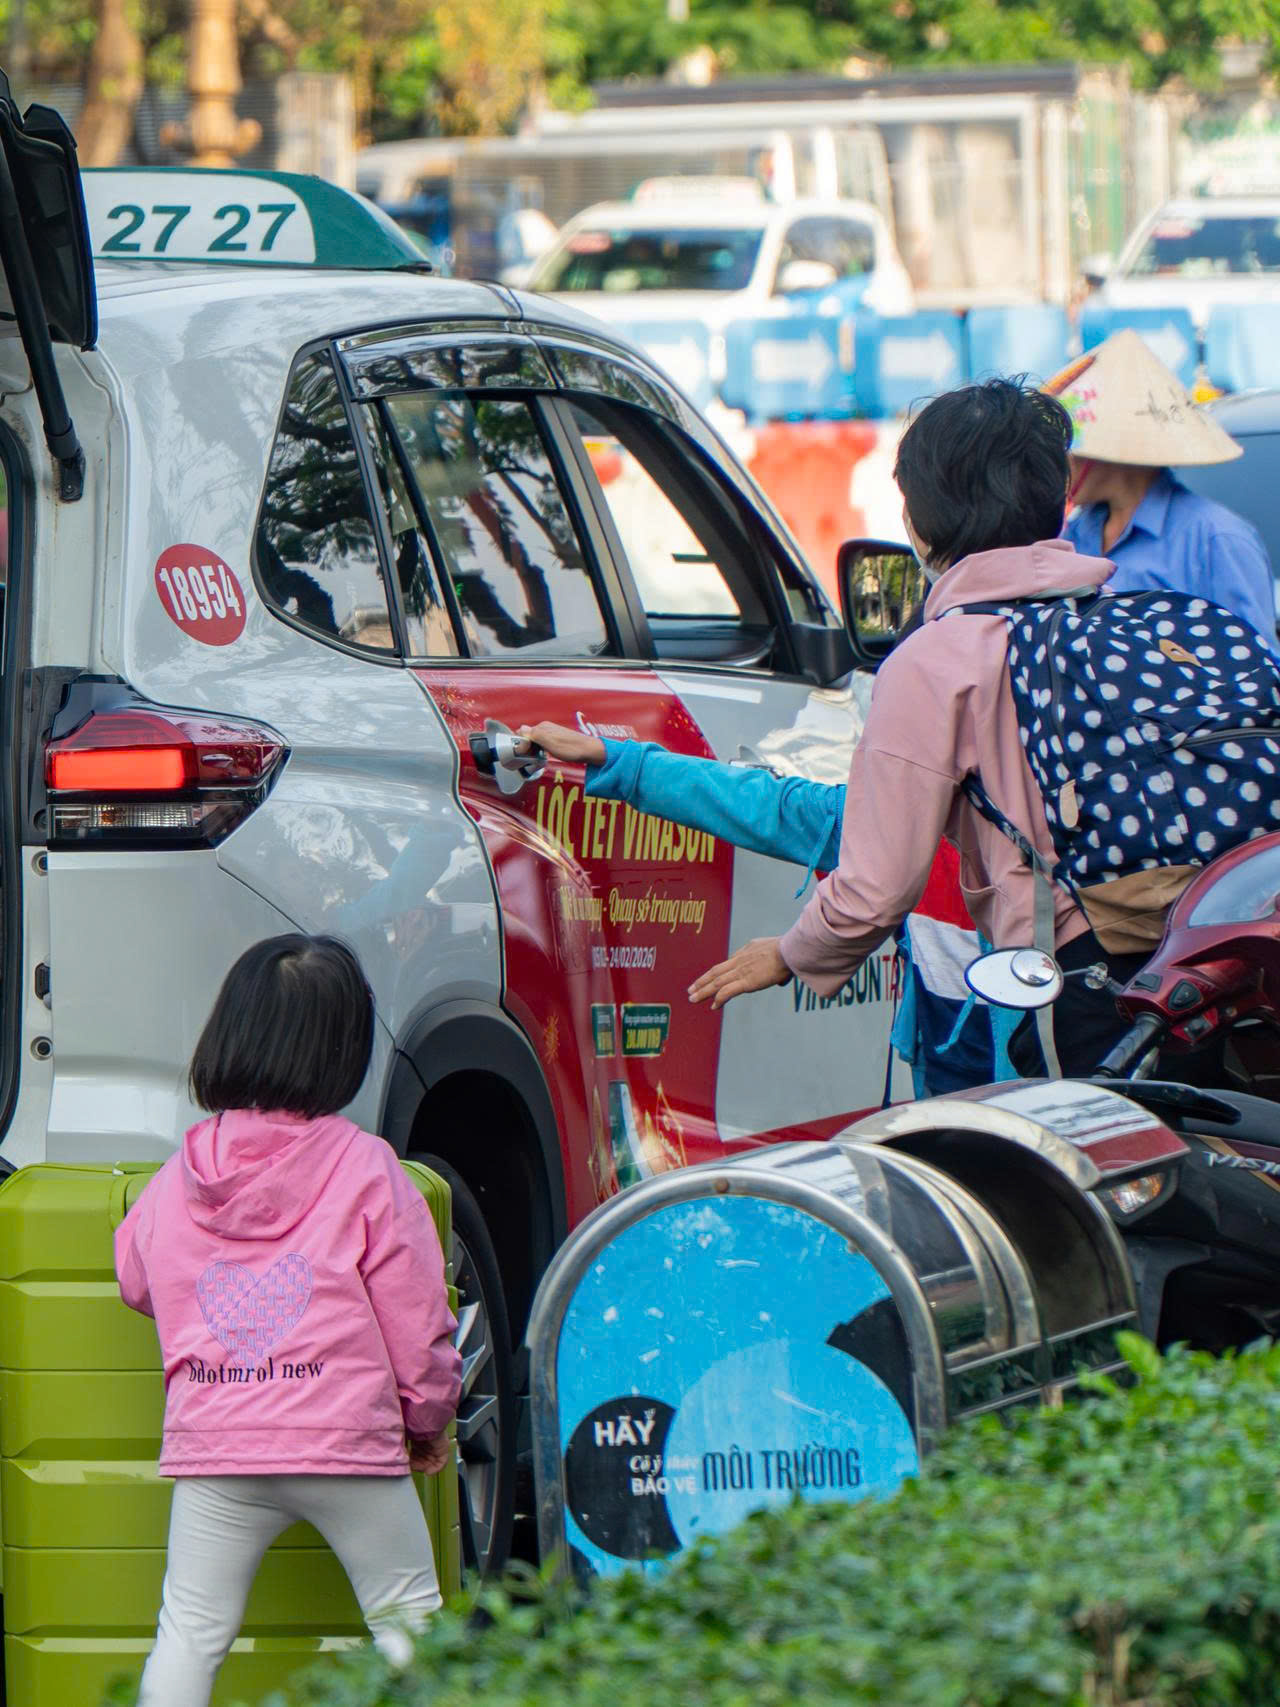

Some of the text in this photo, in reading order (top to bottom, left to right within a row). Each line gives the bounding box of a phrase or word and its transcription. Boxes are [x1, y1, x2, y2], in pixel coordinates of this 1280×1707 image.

[101, 203, 297, 253] 27 27
[159, 564, 242, 621] 18954
[793, 956, 882, 1013] VISUN
[282, 1360, 324, 1379] new
[702, 1443, 754, 1491] MÔI
